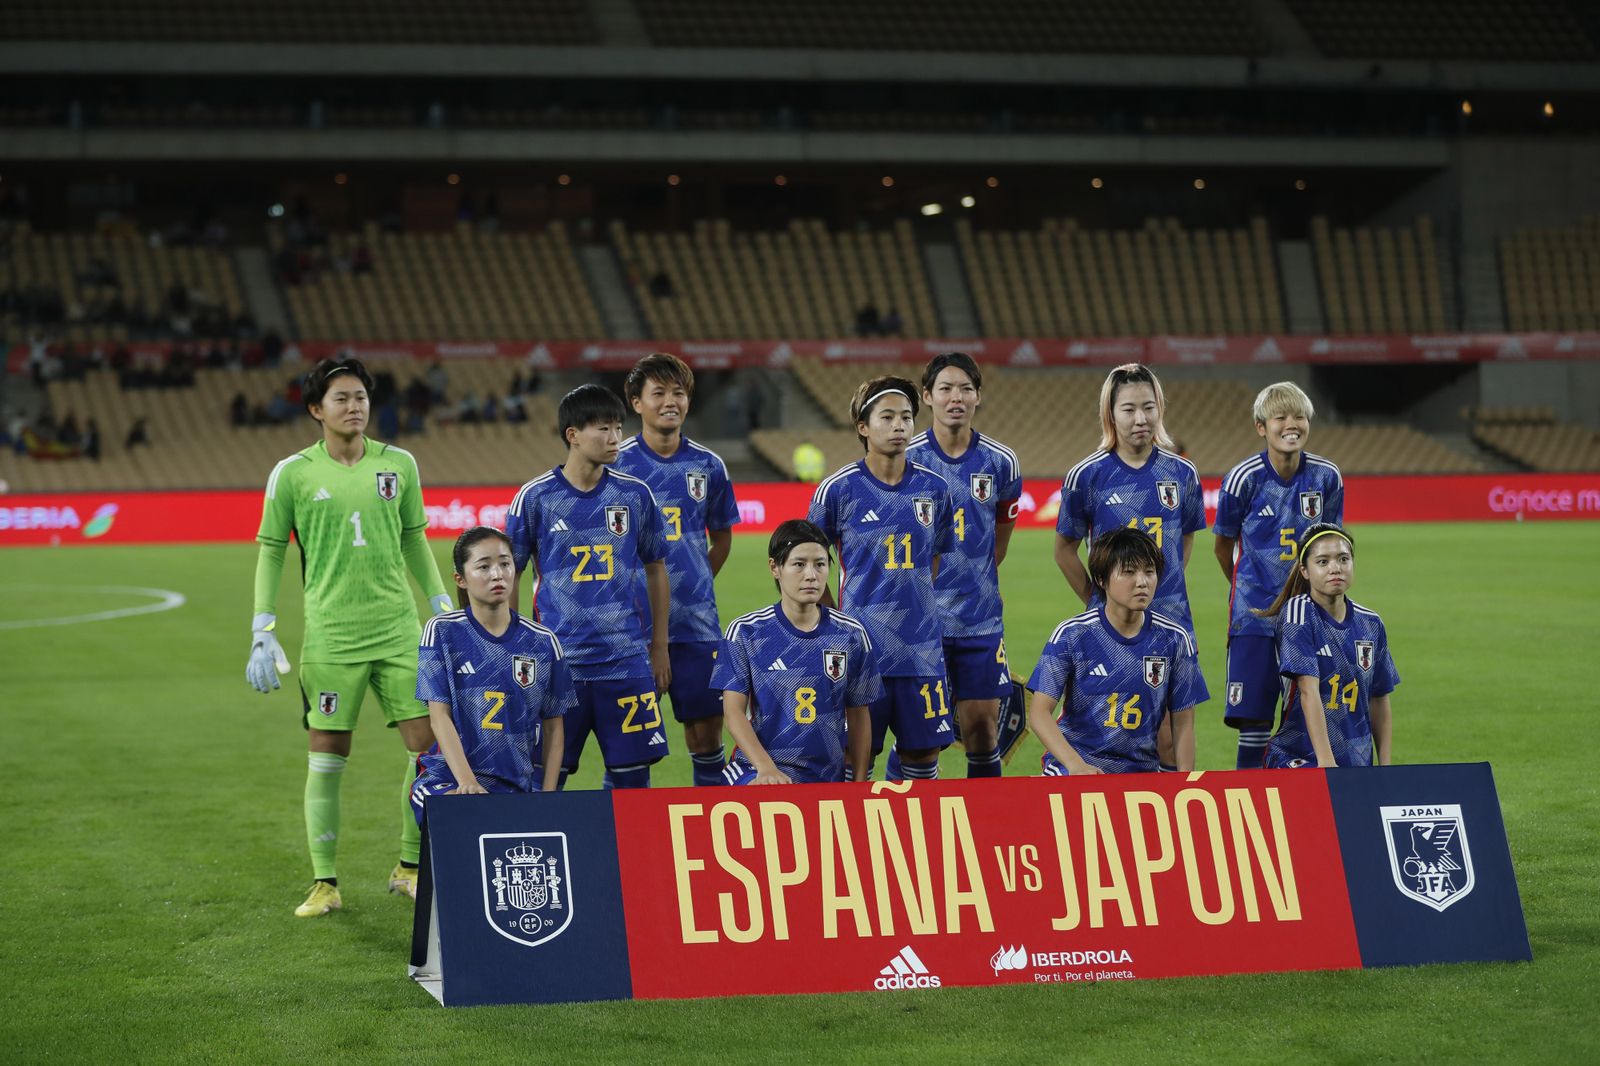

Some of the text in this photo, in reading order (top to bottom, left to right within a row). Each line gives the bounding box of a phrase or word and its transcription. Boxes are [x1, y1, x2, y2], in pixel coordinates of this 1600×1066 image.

[1488, 486, 1573, 512] Conoce
[350, 511, 367, 547] 1
[661, 506, 682, 541] 3
[1127, 516, 1163, 549] 3
[883, 532, 915, 570] 11
[1280, 528, 1298, 561] 5
[570, 543, 615, 583] 23
[481, 690, 505, 730] 2
[794, 686, 817, 725] 8
[920, 680, 949, 719] 11
[1104, 692, 1142, 730] 16
[1326, 673, 1359, 713] 14
[617, 691, 661, 734] 23
[1401, 807, 1443, 817] JAPAN
[668, 779, 995, 944] ESPAÑA
[1048, 770, 1303, 931] JAPÓN
[1417, 876, 1457, 894] JFA
[1031, 949, 1133, 967] IBERDROLA
[1034, 969, 1136, 982] Por ti. Por el planeta.
[873, 972, 941, 991] adidas
